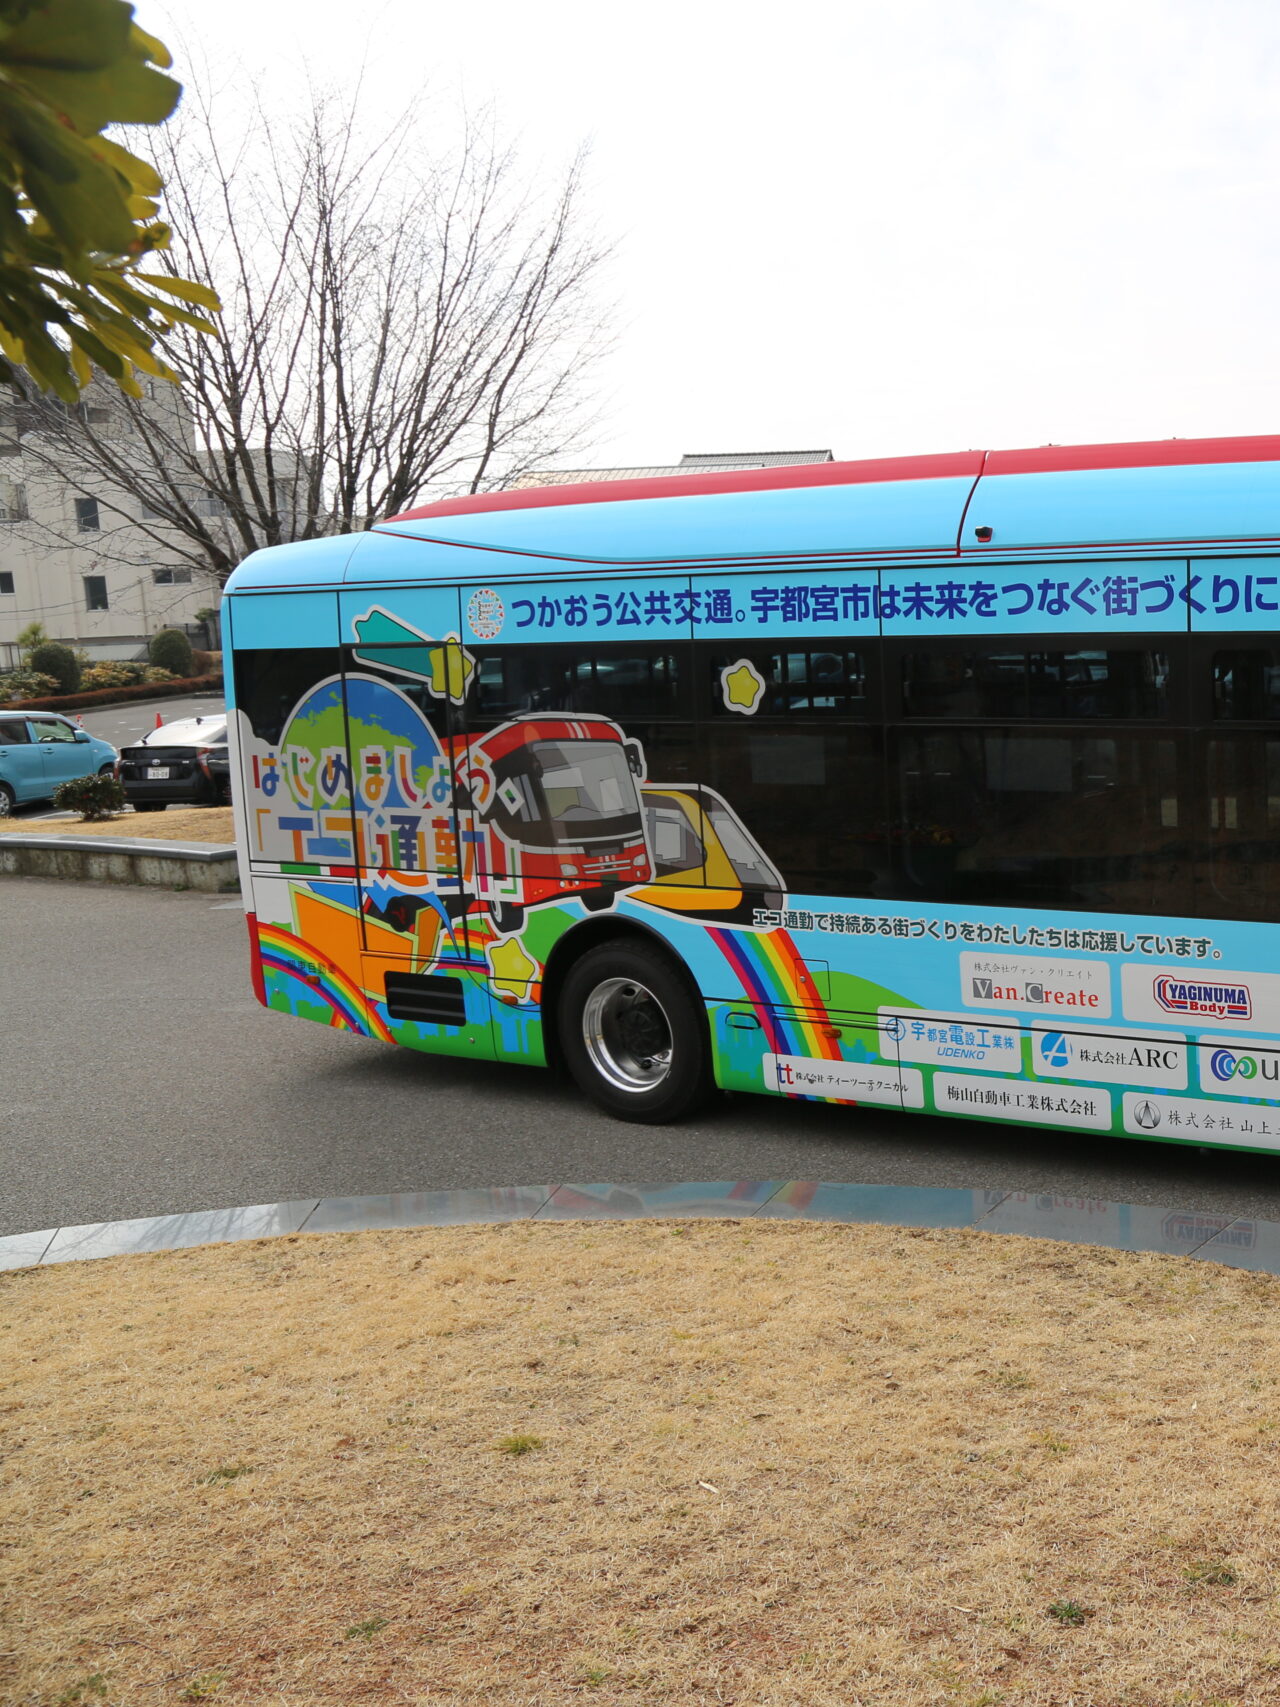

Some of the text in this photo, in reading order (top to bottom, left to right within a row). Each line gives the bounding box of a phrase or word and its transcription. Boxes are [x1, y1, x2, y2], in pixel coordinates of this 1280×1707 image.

[251, 748, 520, 808] はじめましょう。
[255, 807, 519, 895] 「エコ通勤」
[753, 909, 1222, 959] エコ通勤で持続ある街づくりをわたしたちは応援しています。
[974, 962, 1093, 980] 株式会社ヴァン・クリエイト
[973, 978, 1099, 1008] Van.Create
[1169, 983, 1247, 1005] YAGINUMA
[1189, 1001, 1226, 1015] Body
[911, 1021, 1015, 1050] 宇都宮電設工業株
[937, 1047, 985, 1060] UDENKO
[795, 1071, 909, 1092] 株式会社 ティーツーテクニカル
[947, 1085, 1097, 1116] 梅山自動車工業株式会社
[1168, 1110, 1234, 1131] 株式会社
